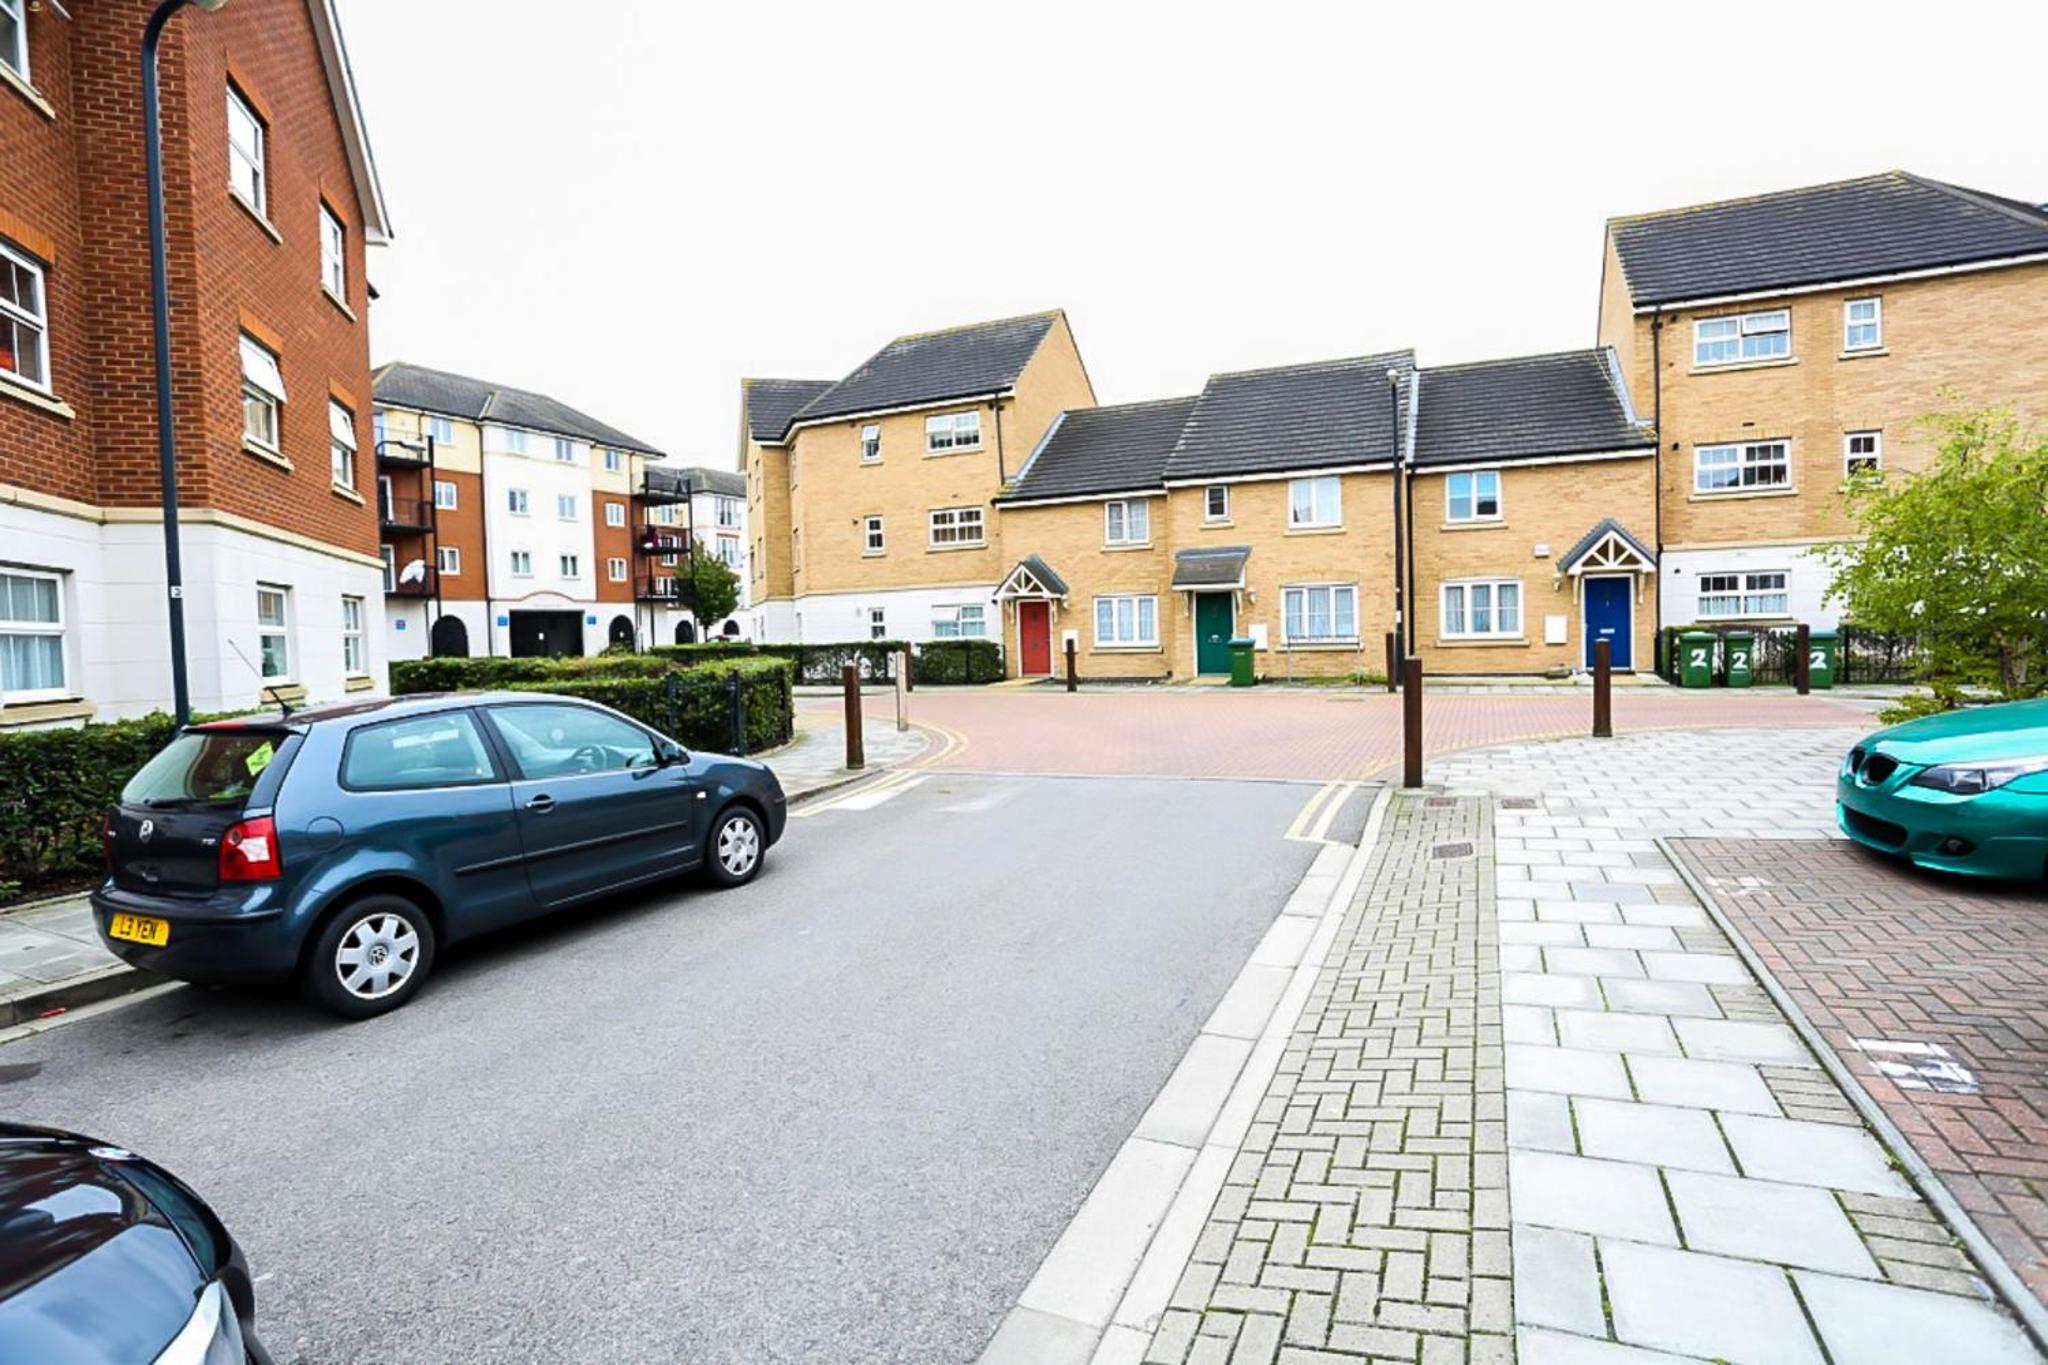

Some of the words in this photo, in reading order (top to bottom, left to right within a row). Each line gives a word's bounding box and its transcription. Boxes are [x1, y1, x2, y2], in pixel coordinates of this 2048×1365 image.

[1690, 648, 1708, 668] 2
[1732, 651, 1748, 669] 2
[1809, 651, 1827, 669] 2
[119, 914, 134, 936] L3
[136, 918, 159, 940] YEN
